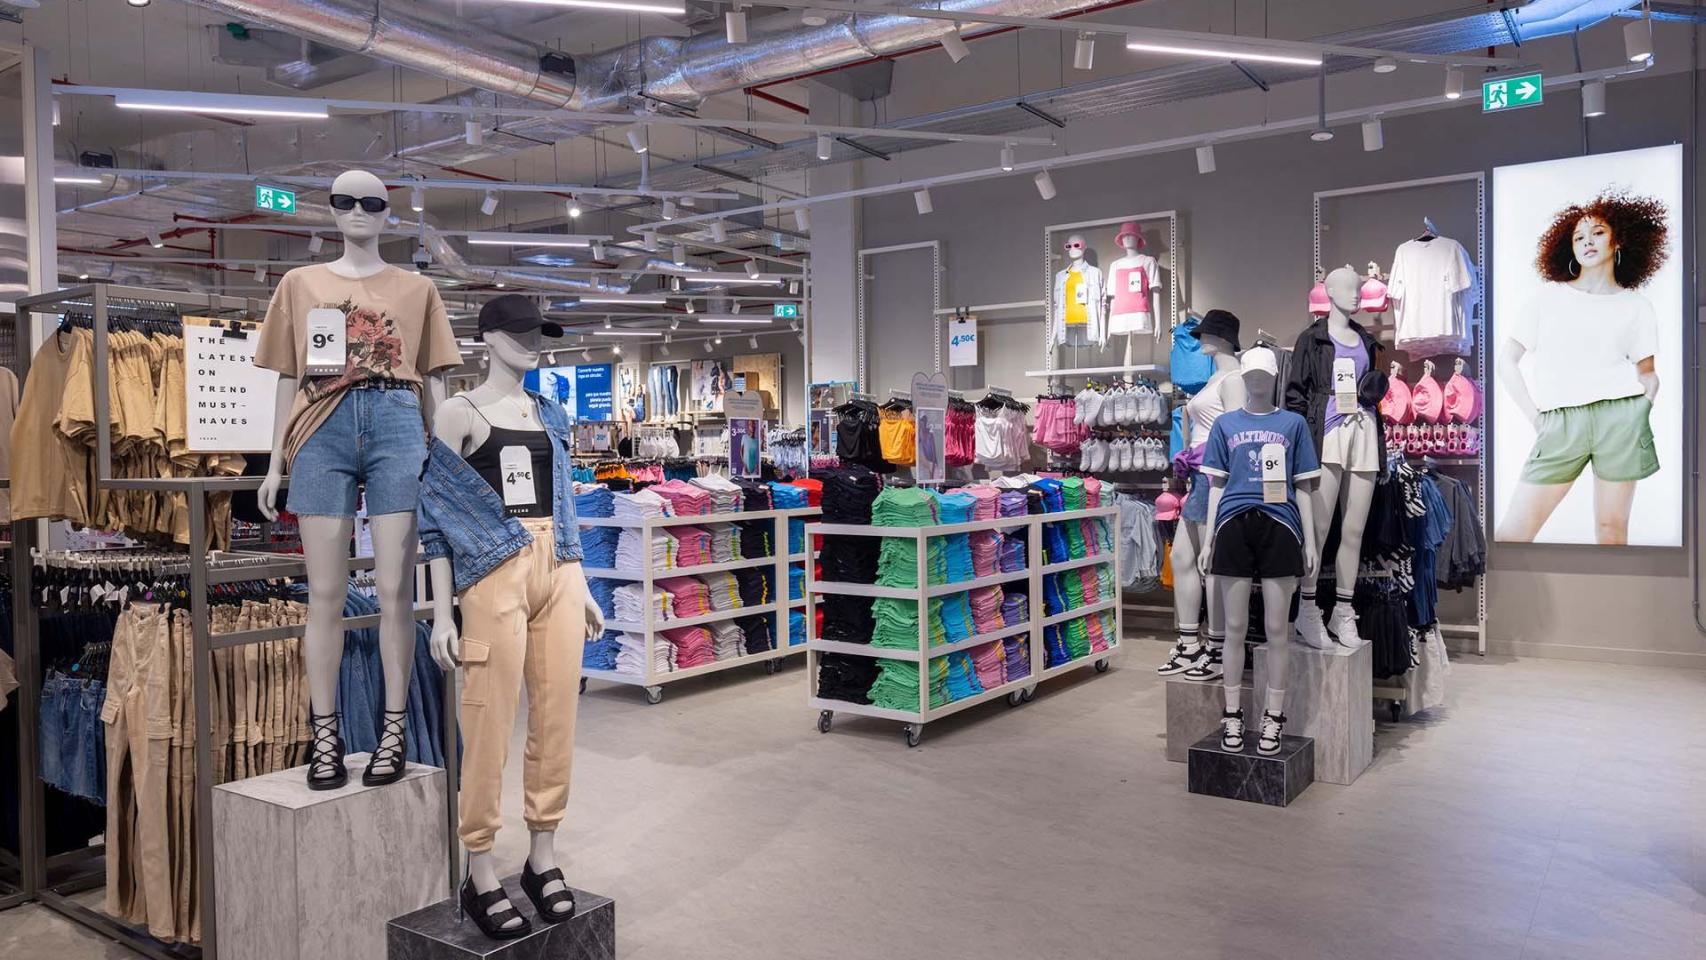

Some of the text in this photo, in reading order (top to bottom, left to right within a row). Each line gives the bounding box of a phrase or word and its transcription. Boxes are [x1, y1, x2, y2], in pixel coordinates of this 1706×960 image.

[198, 337, 225, 345] THE
[312, 333, 335, 349] 9€
[198, 353, 256, 363] LATEST
[198, 385, 247, 394] TREND
[198, 401, 247, 409] MUST-
[199, 417, 248, 425] HAVES
[1265, 459, 1279, 471] 9€
